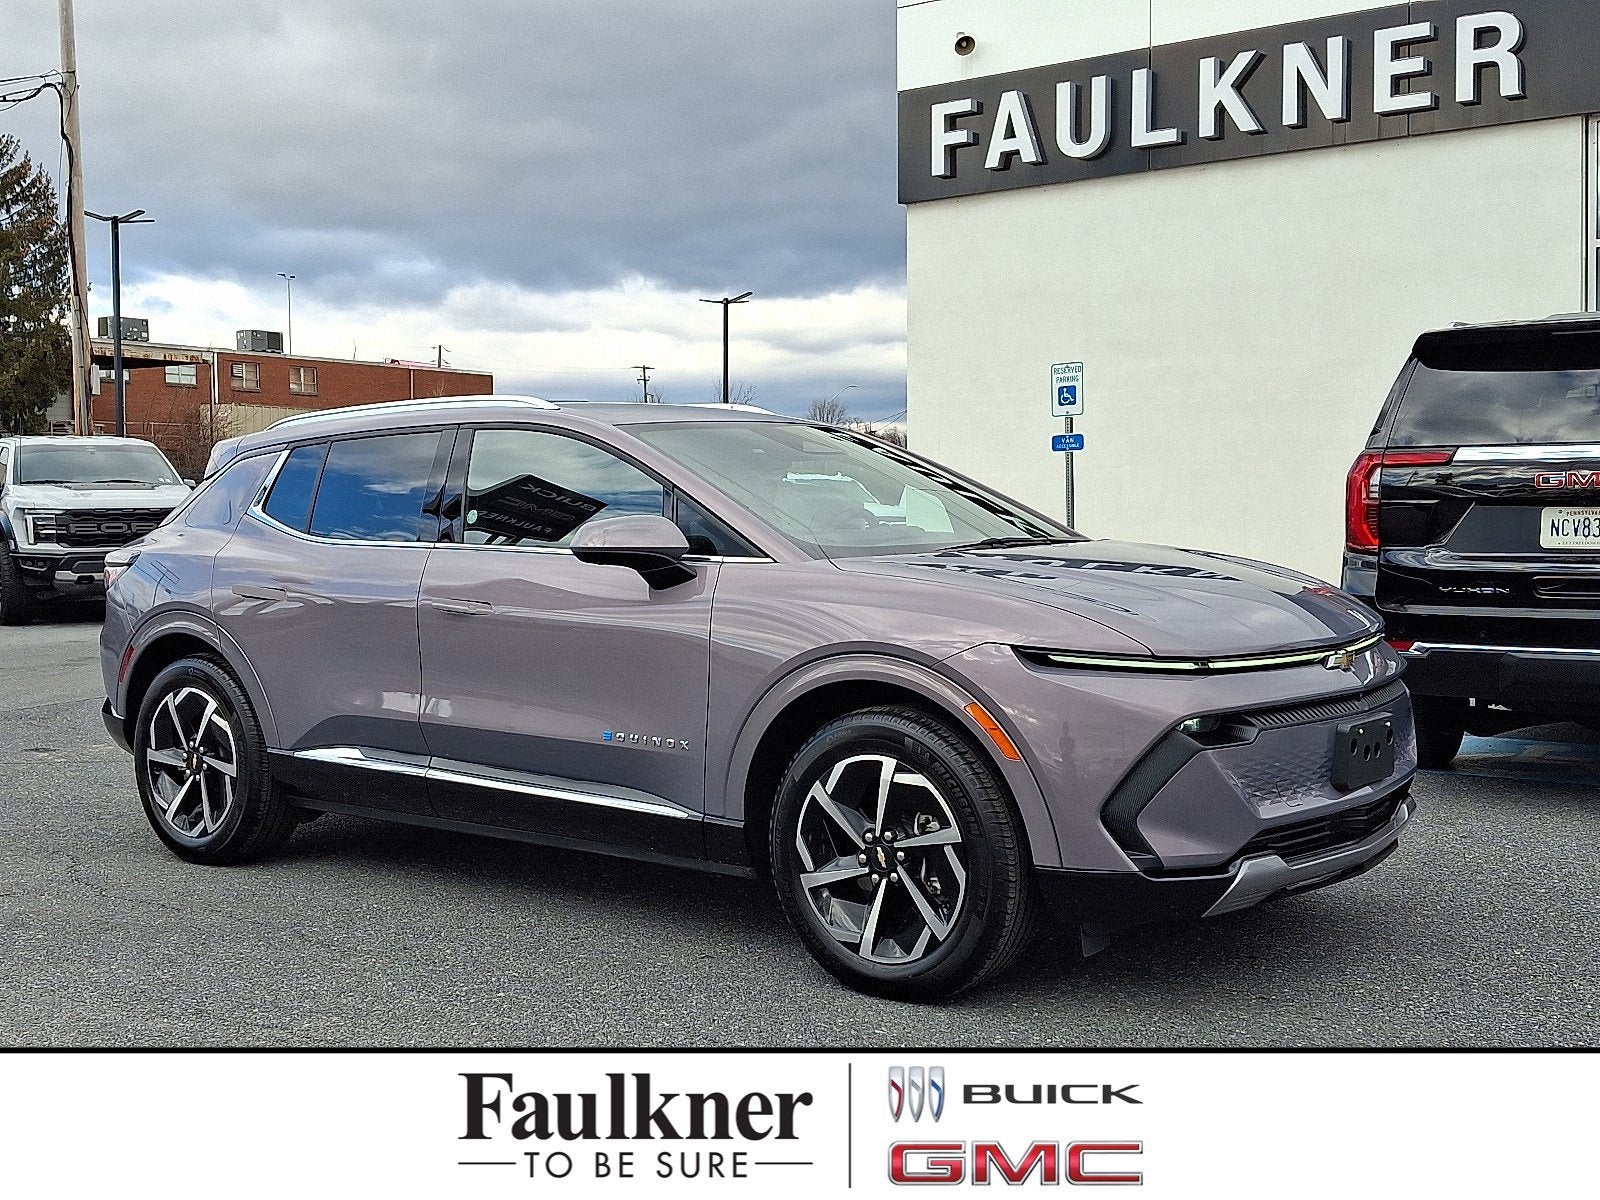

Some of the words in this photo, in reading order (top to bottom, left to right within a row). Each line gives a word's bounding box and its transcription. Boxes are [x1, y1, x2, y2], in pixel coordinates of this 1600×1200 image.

[931, 10, 1524, 178] FAULKNER
[1053, 365, 1082, 375] RESERVED
[1056, 375, 1080, 384] PARKING
[1550, 517, 1600, 538] NCV83
[602, 730, 689, 751] EQUINOX
